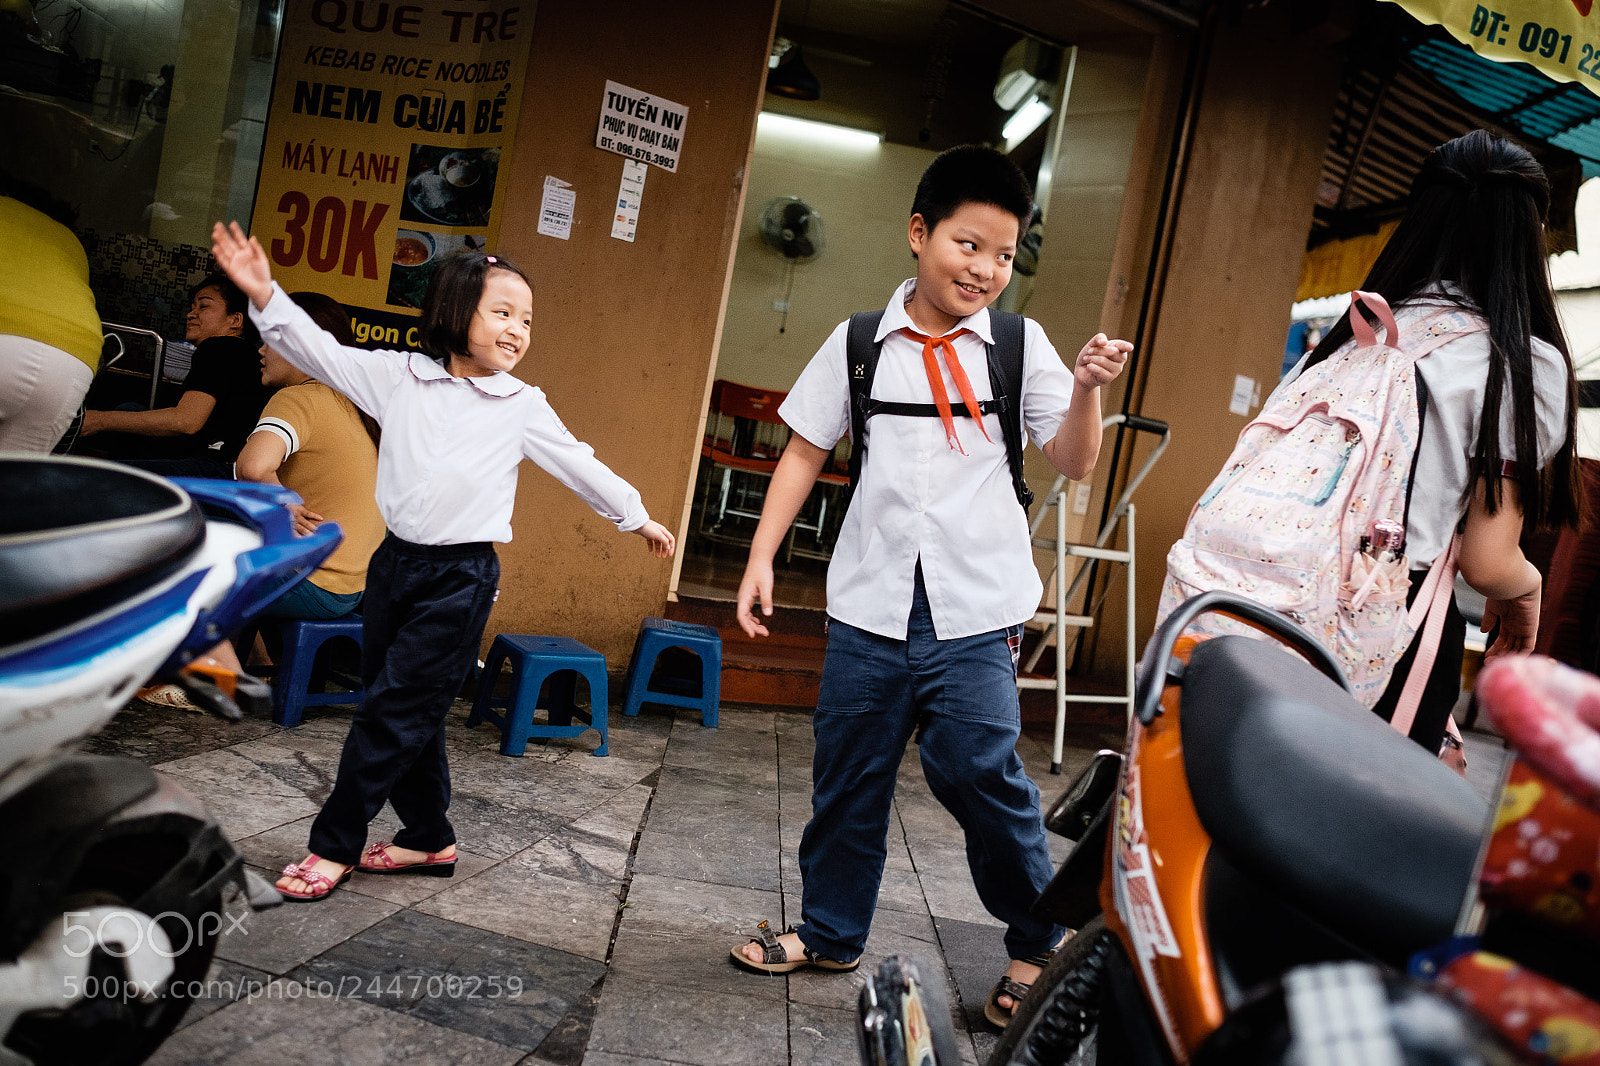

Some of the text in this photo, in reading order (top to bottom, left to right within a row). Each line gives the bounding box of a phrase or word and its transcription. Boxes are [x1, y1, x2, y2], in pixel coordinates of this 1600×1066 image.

[1469, 4, 1510, 46] ĐT:
[1518, 22, 1572, 64] 091
[304, 45, 511, 83] KEBAB RICE NOODLES
[292, 80, 382, 124] NEM
[608, 91, 684, 131] TUYỂN NV
[603, 115, 626, 136] PHỤC
[627, 122, 638, 142] VỤ
[639, 127, 661, 148] CHẠY
[282, 139, 400, 187] MÁY LẠNH
[617, 142, 675, 169] 096.676.3993
[270, 190, 390, 280] 30K
[405, 327, 423, 349] C
